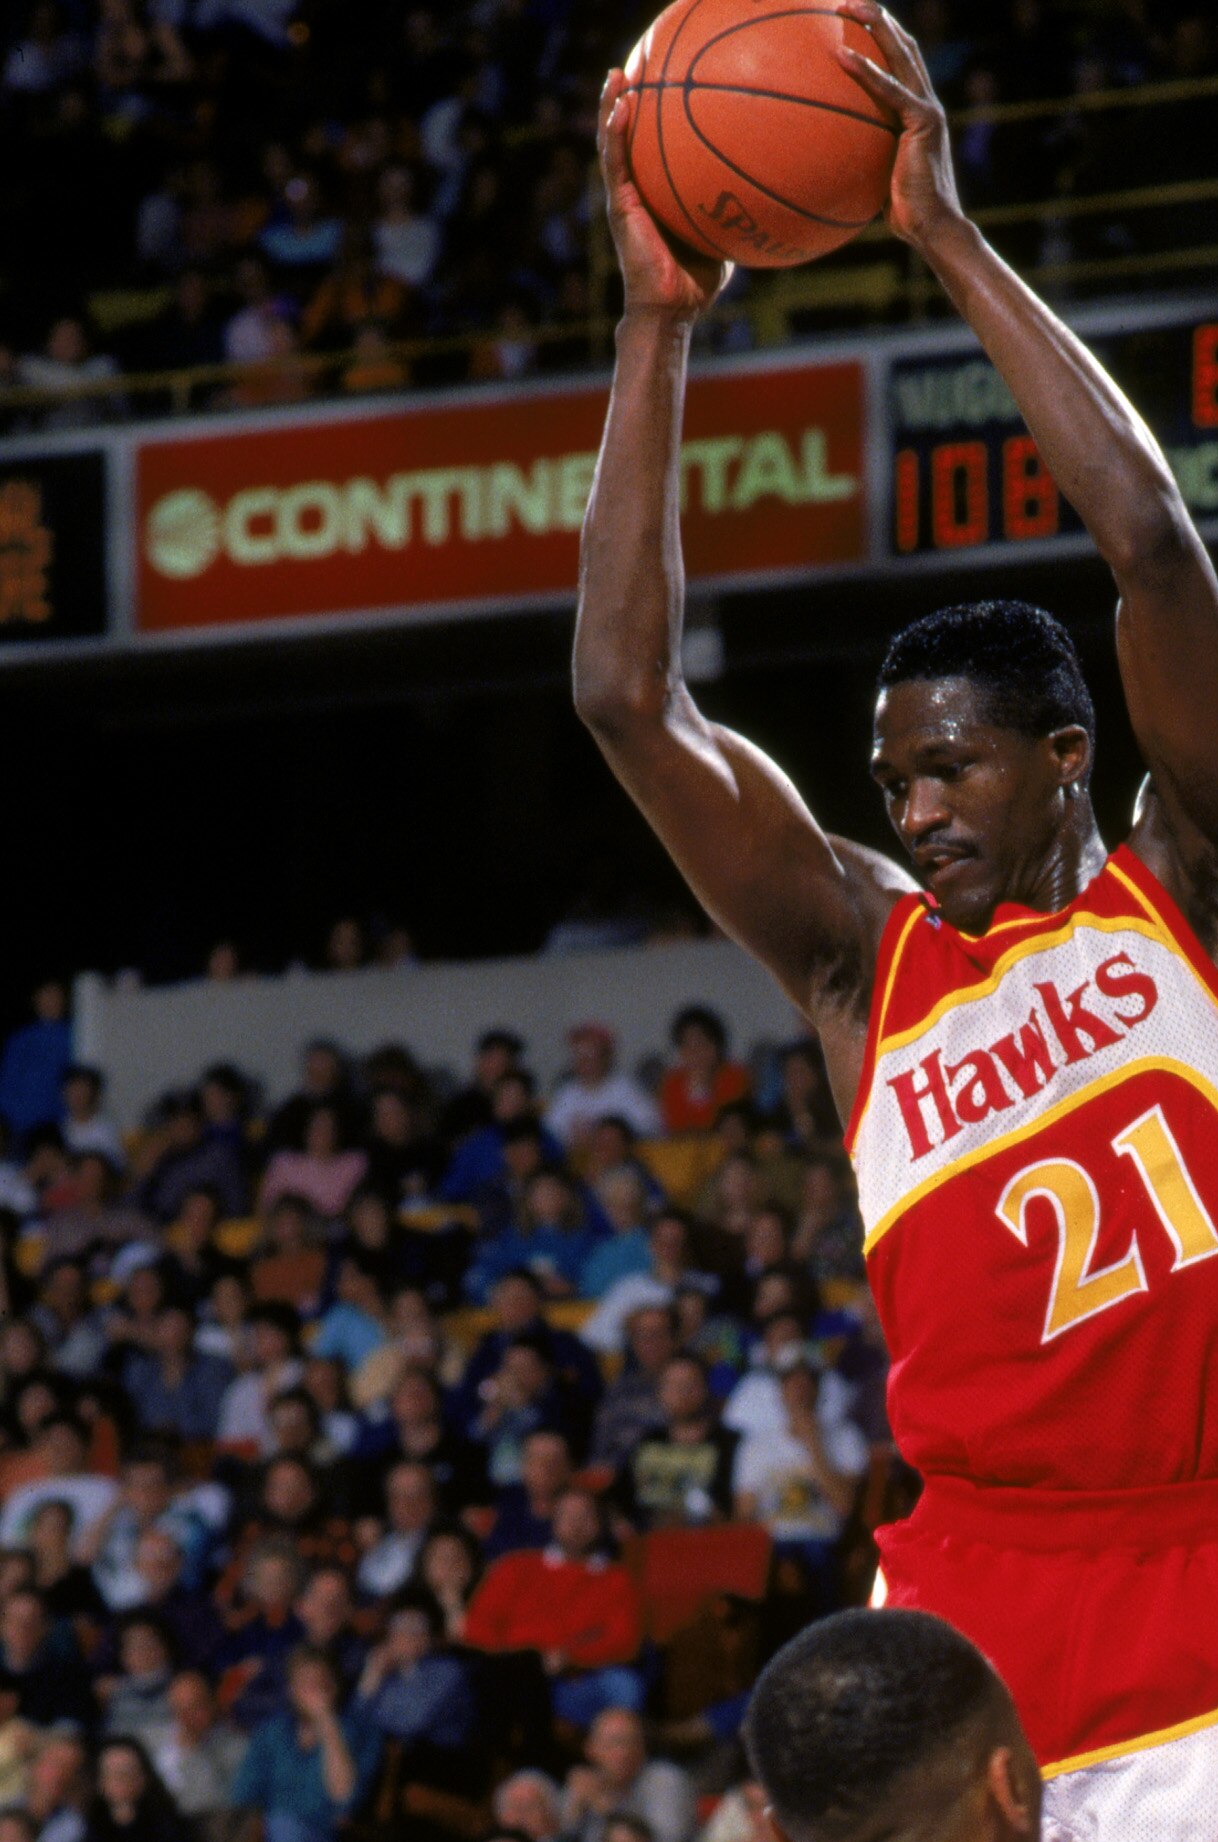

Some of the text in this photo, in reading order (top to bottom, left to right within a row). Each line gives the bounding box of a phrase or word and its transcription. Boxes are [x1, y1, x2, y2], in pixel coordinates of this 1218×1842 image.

[221, 429, 859, 567] CONTINETAL
[895, 435, 1059, 551] 108
[886, 951, 1160, 1163] Hawks
